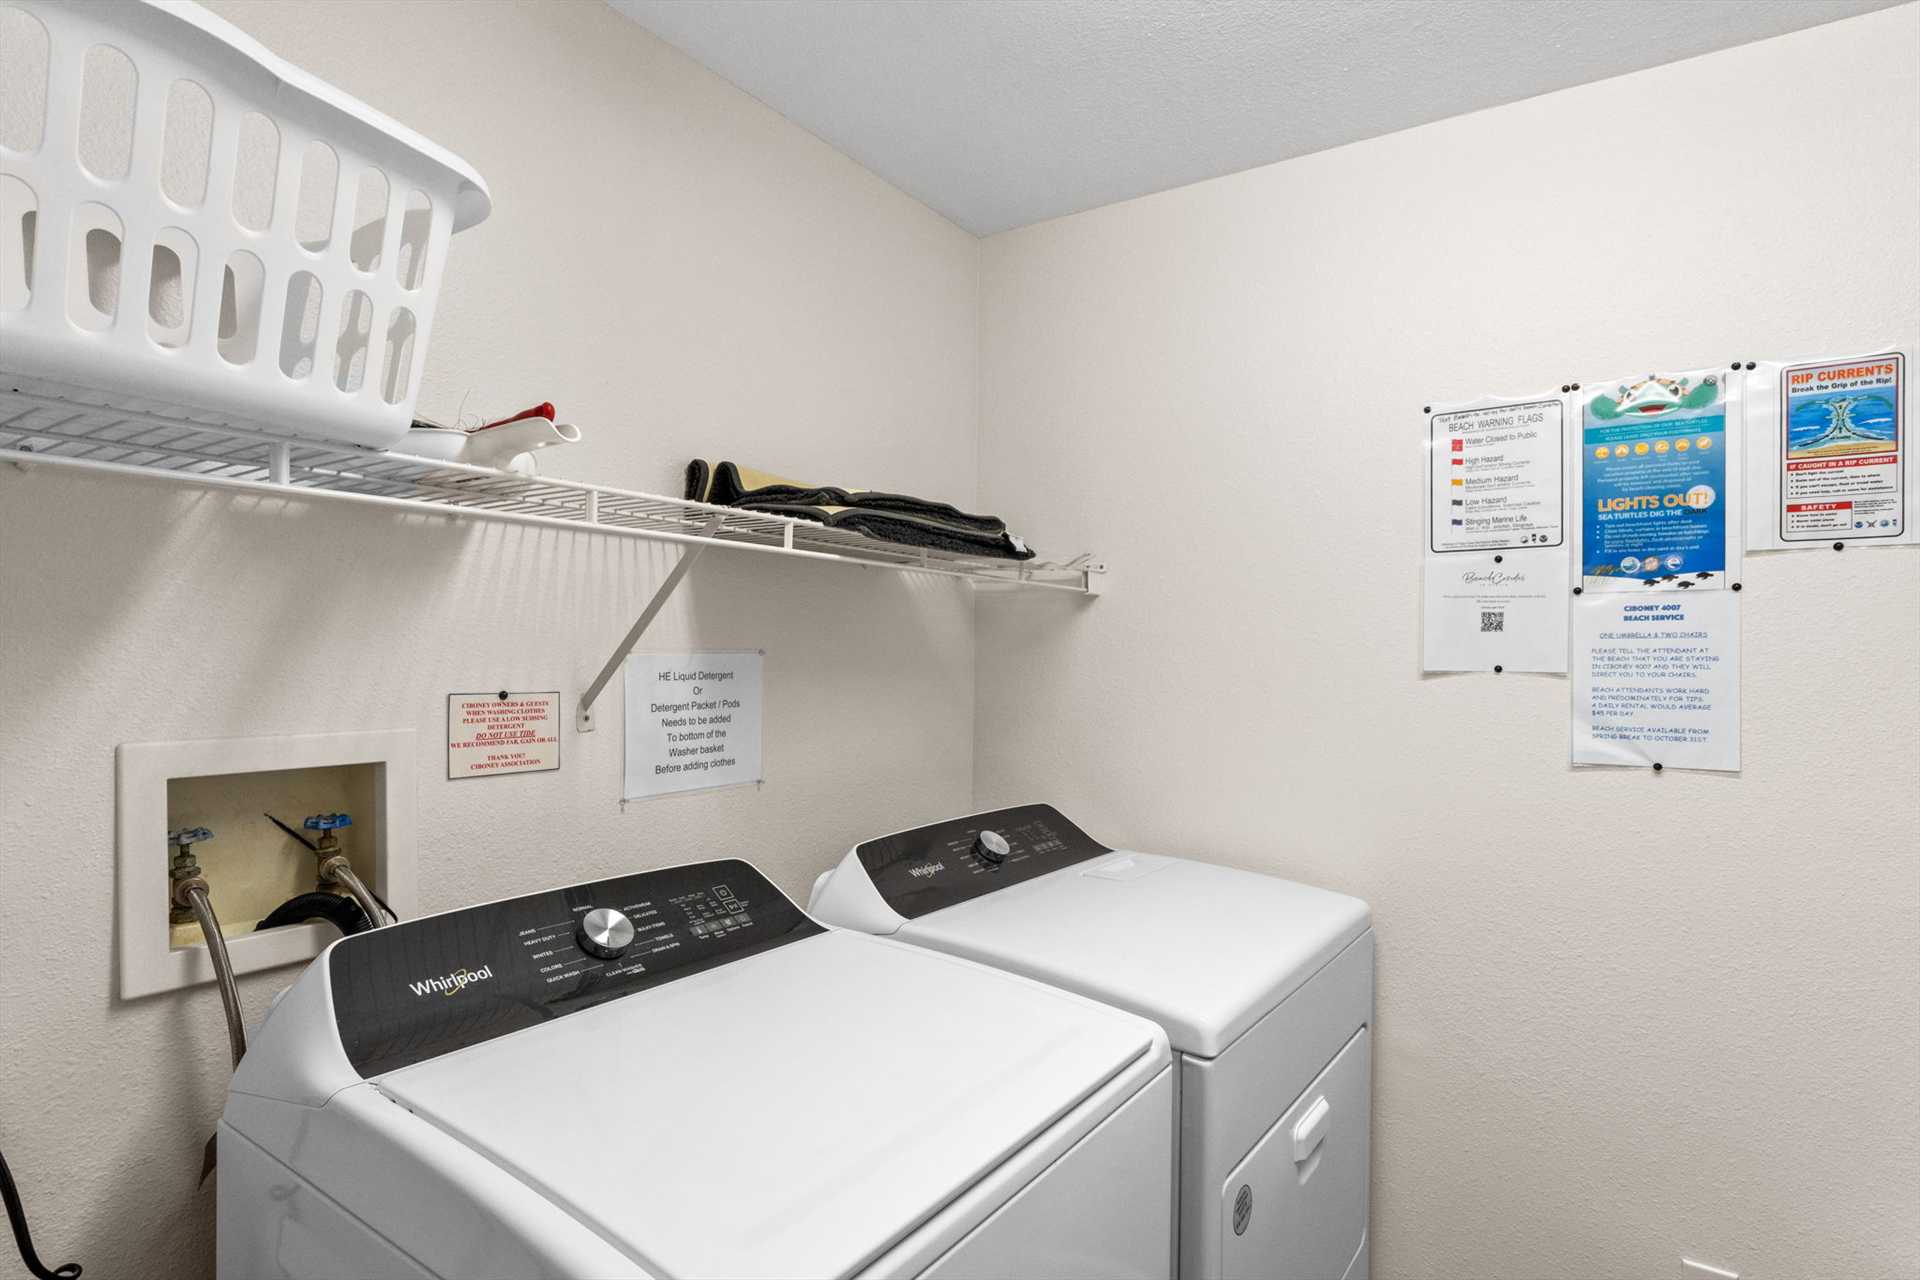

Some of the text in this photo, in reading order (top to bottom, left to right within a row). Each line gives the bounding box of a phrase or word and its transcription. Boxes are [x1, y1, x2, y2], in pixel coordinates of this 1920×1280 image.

[1792, 364, 1893, 384] RIP CURRENTS
[1792, 385, 1814, 393] Break
[1449, 423, 1473, 432] BEACH
[1478, 417, 1513, 428] WARNING
[1518, 413, 1544, 423] FLAGS
[1486, 434, 1508, 443] Closed
[1517, 431, 1537, 439] Public
[1465, 457, 1480, 465] High
[1465, 474, 1518, 485] Medium Hazard
[1482, 496, 1507, 504] Hazard
[1598, 493, 1708, 512] LIGHTS OUT!
[1465, 517, 1490, 526] Stinging
[658, 671, 733, 682] HE Liquid Detergent
[693, 686, 703, 695] Or
[651, 702, 689, 713] Detergent
[691, 701, 716, 710] Packet
[722, 699, 740, 708] Pods
[662, 715, 731, 727] Needs to be added
[668, 730, 726, 742] To bottom of the
[463, 740, 505, 748] RECOMMEND
[669, 744, 724, 757] Washer basket
[470, 759, 541, 770] CIBONEY ASSOCIATION
[656, 758, 735, 774] Before adding clothes
[409, 965, 494, 997] Whirlpool
